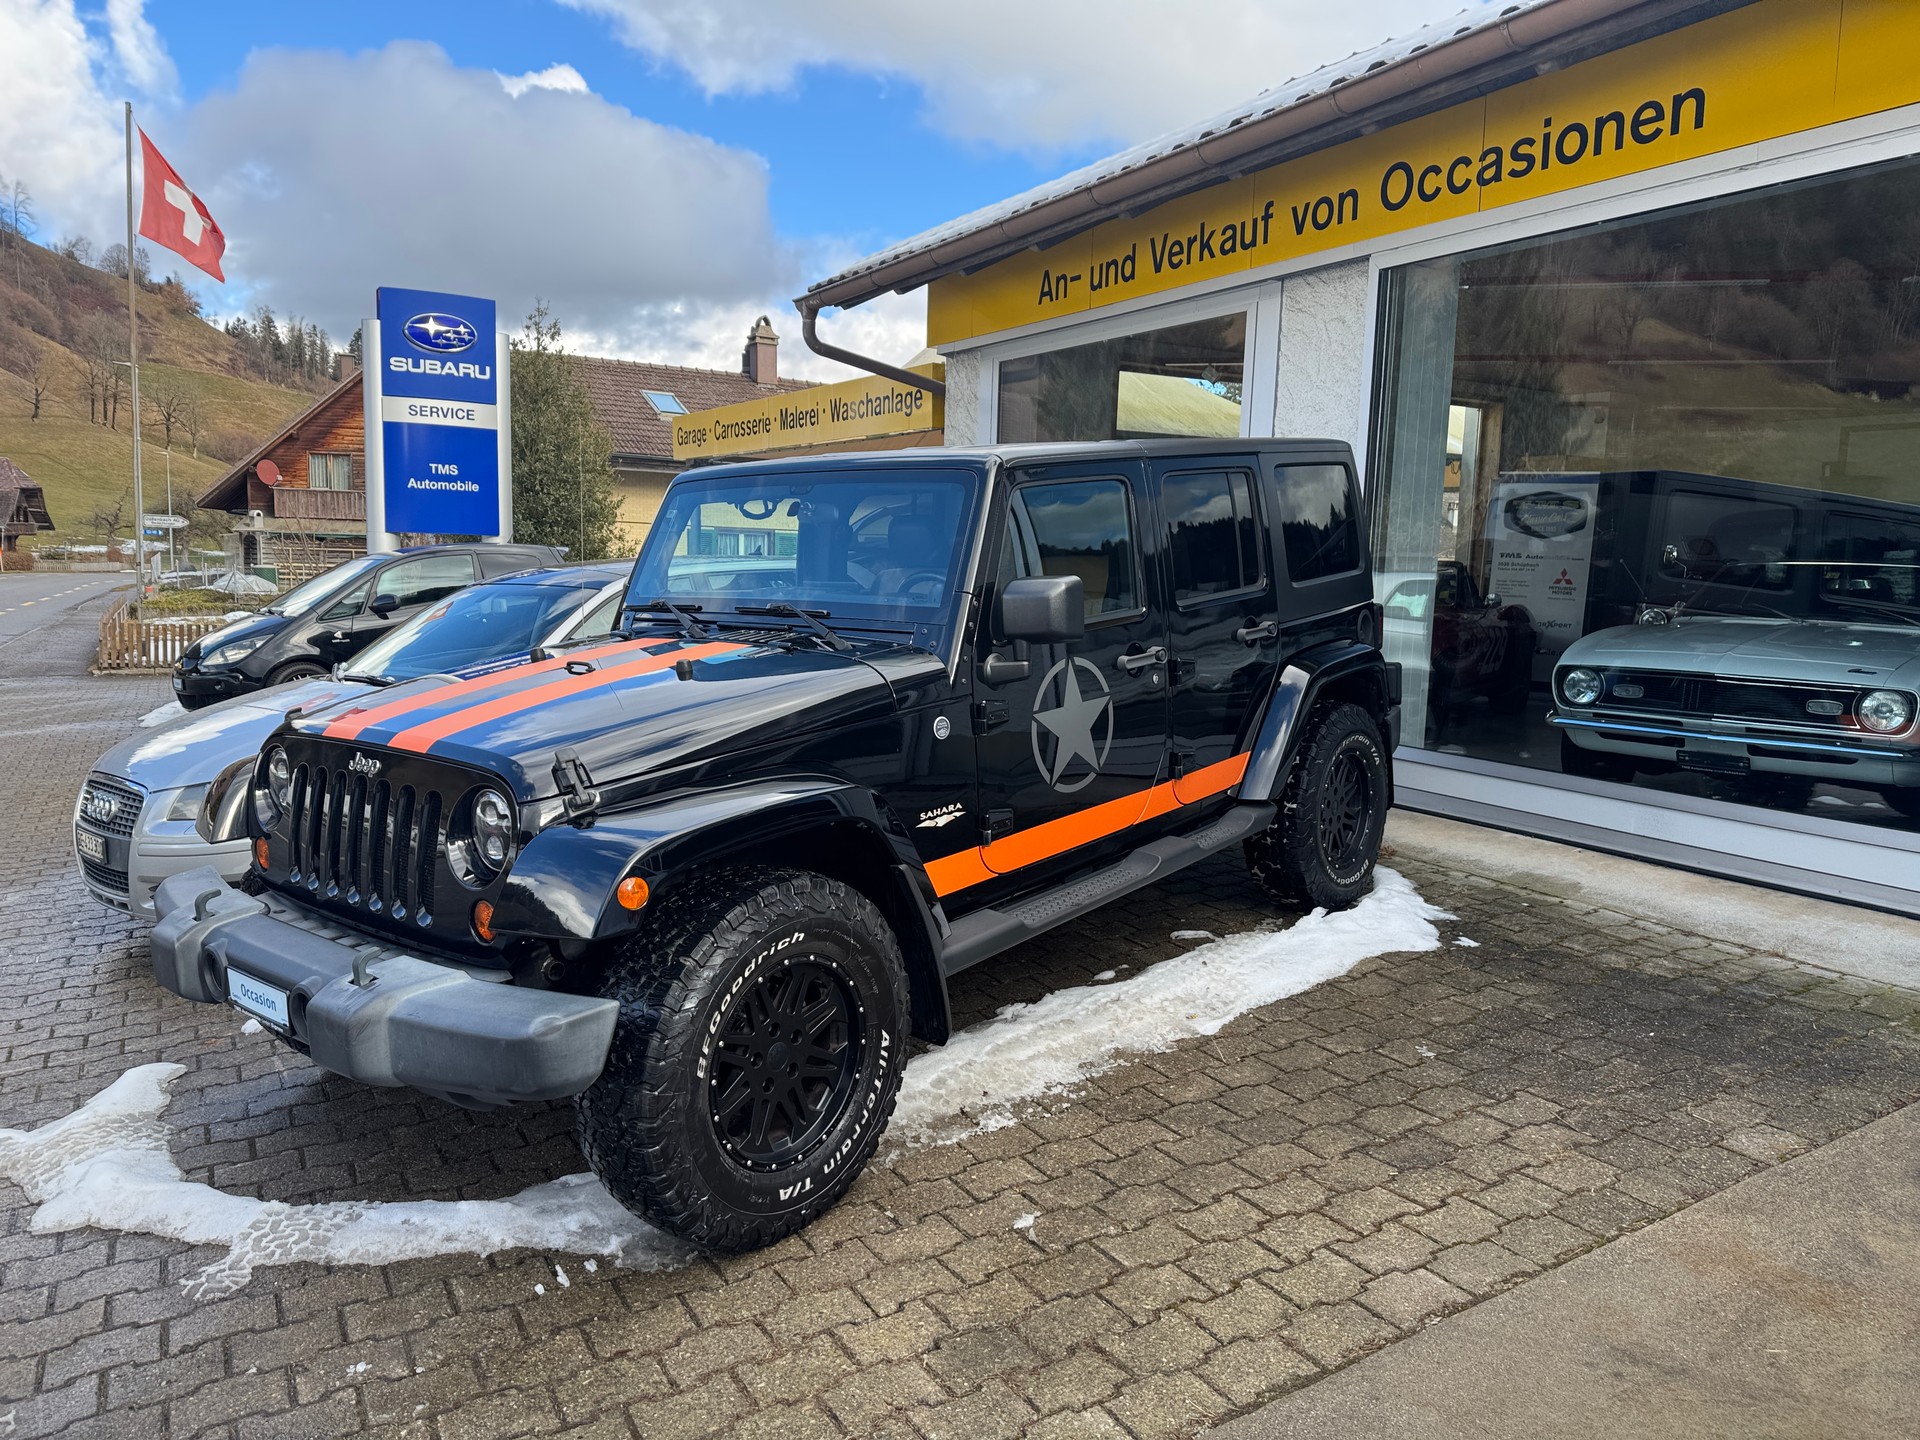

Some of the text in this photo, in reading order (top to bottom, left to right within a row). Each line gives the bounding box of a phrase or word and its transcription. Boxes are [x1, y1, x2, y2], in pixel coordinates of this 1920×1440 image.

[1089, 243, 1137, 293] und
[1150, 203, 1274, 275] Verkauf
[1292, 185, 1359, 236] von
[1380, 86, 1706, 213] Occasionen
[389, 356, 491, 380] SUBARU
[408, 404, 475, 421] SERVICE
[676, 387, 923, 447] Garage Carrosserie Malerei Waschanlage
[429, 463, 459, 476] TMS
[407, 478, 480, 492] Automobile
[348, 751, 382, 778] Jeep
[919, 802, 963, 821] SAHARA
[240, 983, 277, 1012] Occasion
[696, 931, 806, 1080] BFGoodrich
[823, 1028, 890, 1175] All-Terrain
[778, 1177, 816, 1202] T/A
